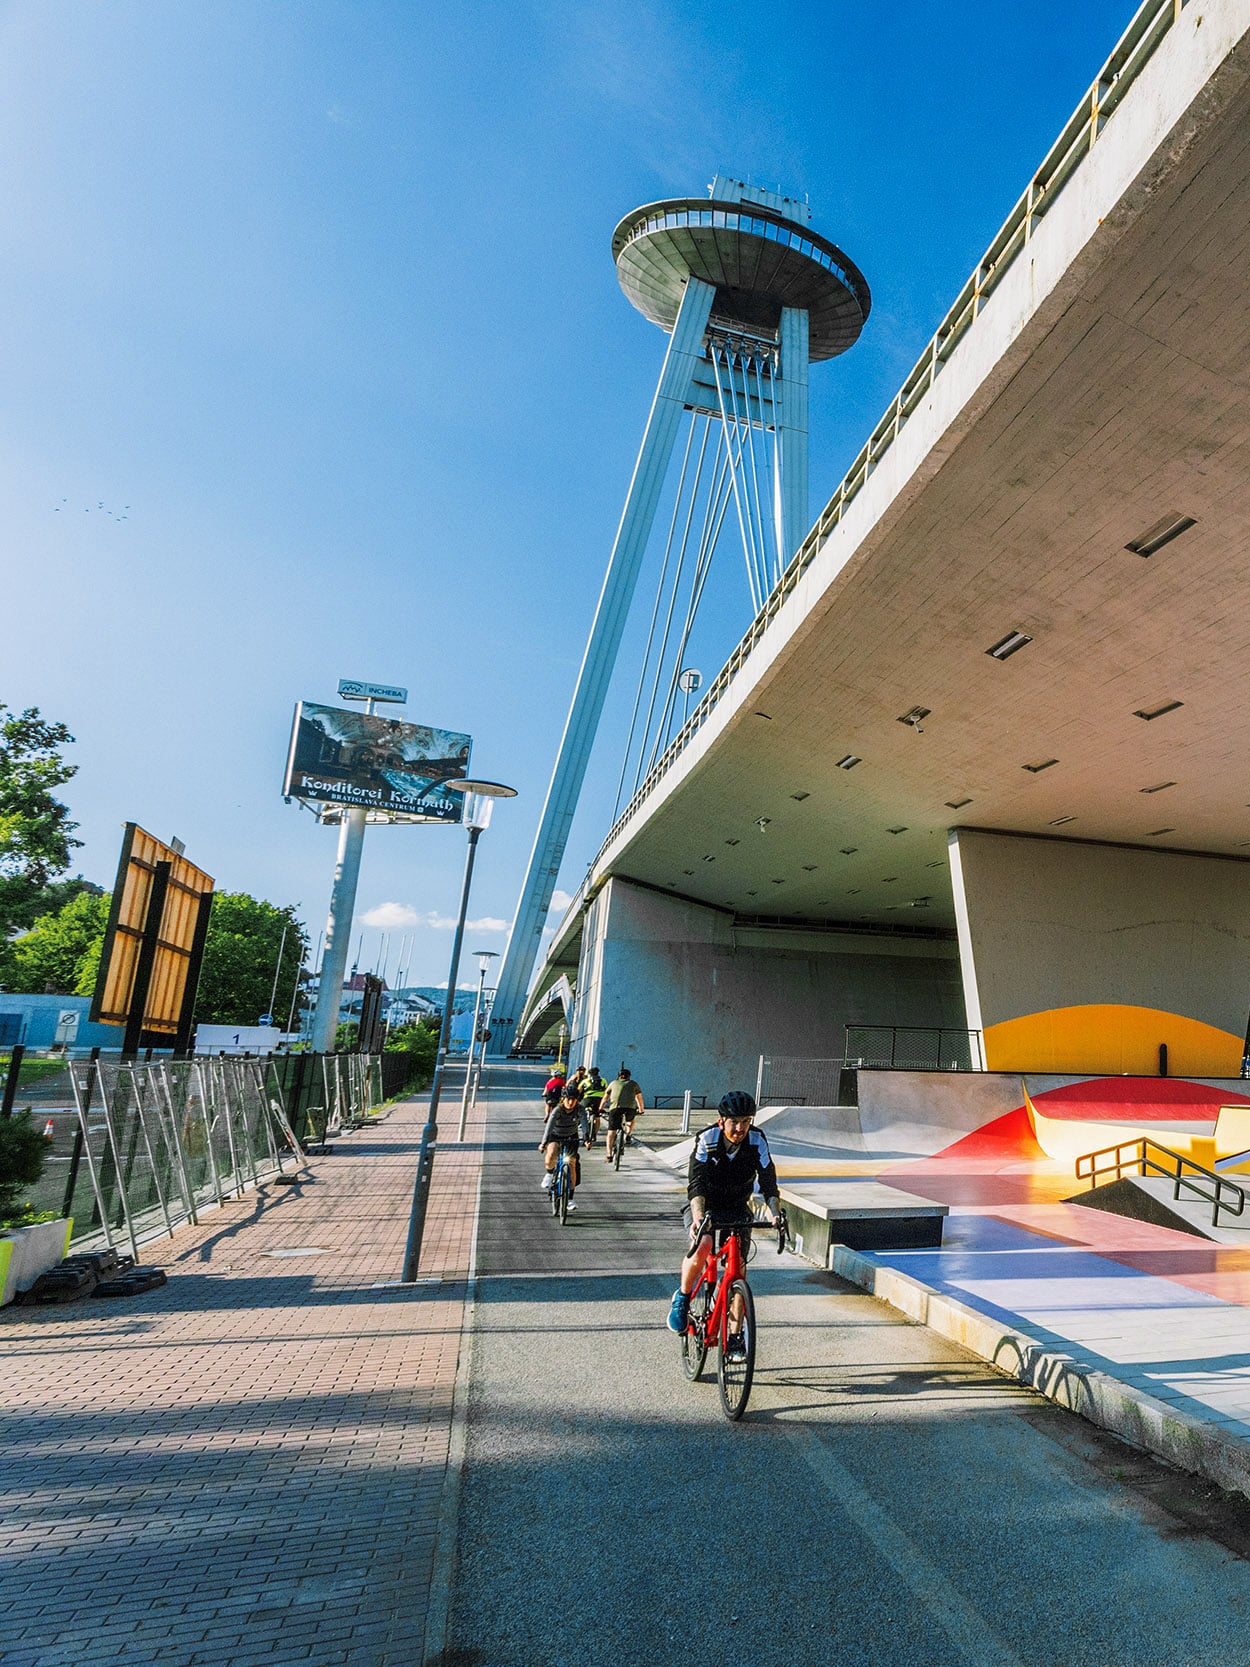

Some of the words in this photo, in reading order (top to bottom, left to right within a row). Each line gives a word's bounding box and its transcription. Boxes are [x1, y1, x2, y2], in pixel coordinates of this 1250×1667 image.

[368, 687, 403, 697] INCHEBA
[301, 776, 382, 799] Konditorei
[331, 793, 378, 806] BRATISLAVA
[379, 801, 416, 812] CENTRUM
[232, 1034, 240, 1044] 1
